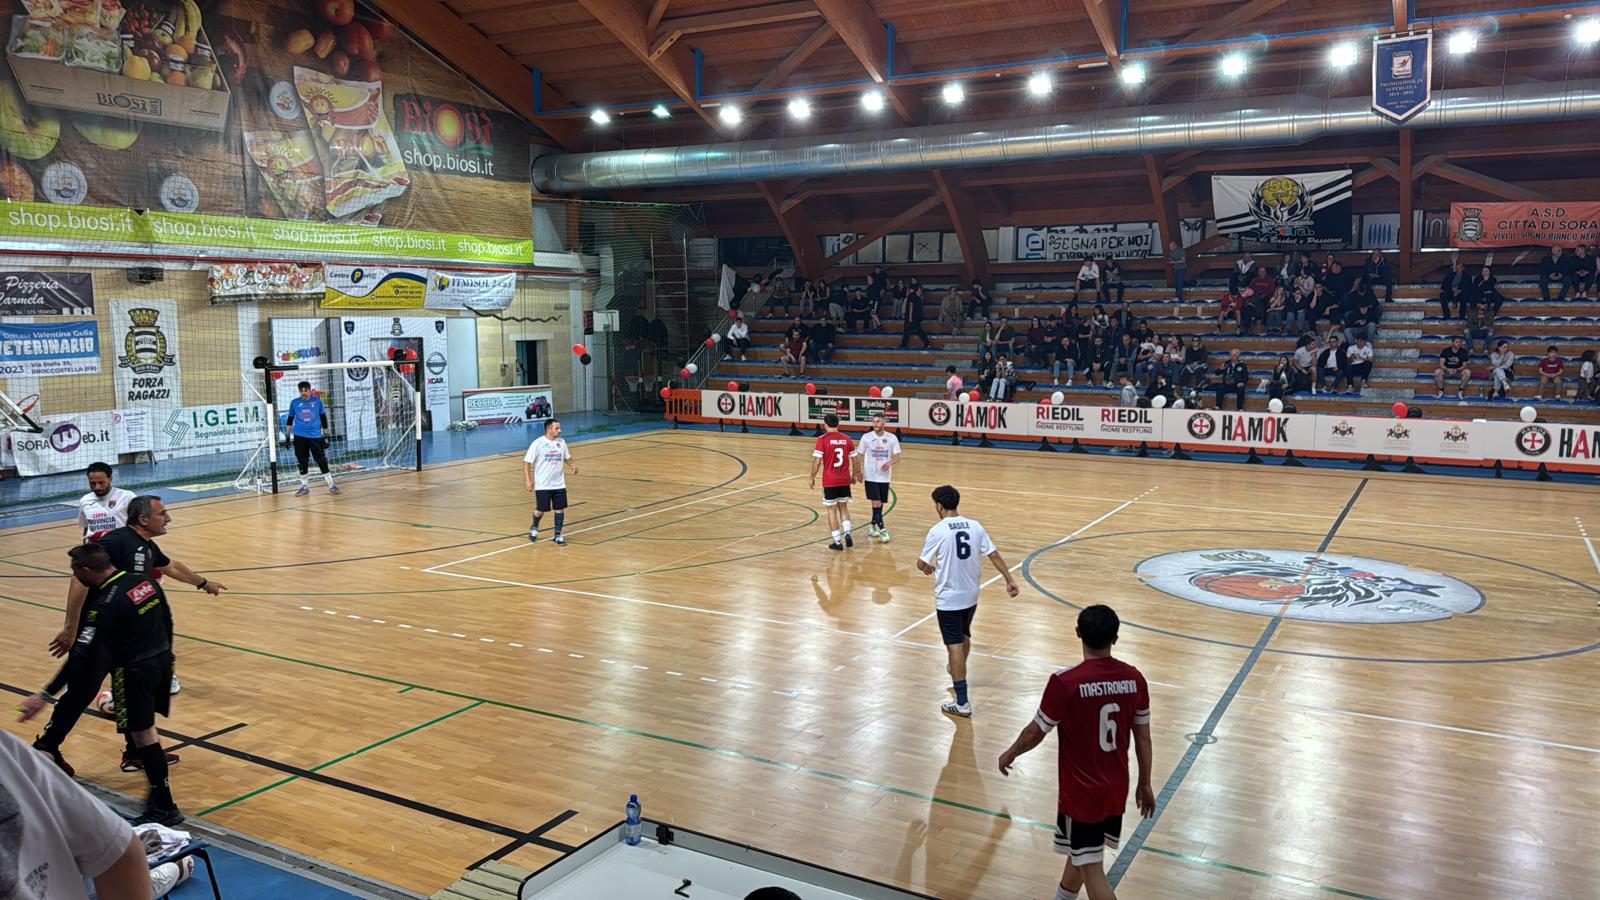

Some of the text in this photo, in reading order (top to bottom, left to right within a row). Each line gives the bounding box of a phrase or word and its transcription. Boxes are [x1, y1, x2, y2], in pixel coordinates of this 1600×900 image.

[1541, 220, 1555, 230] DI
[1559, 220, 1598, 230] SORA
[1053, 233, 1151, 251] SEGNA PER NOI
[5, 275, 61, 294] Pizzeria
[32, 330, 72, 340] Valentina
[132, 377, 164, 389] FORZA
[128, 389, 170, 402] RAGAZZI
[467, 396, 503, 409] RECCHIA
[739, 394, 782, 418] HAMOK
[1036, 406, 1084, 421] RIEDIL
[956, 403, 1008, 429] HAMOK
[1101, 408, 1153, 424] RIEDIL
[194, 429, 236, 439] Segnaletica
[1037, 423, 1085, 432] HOME RESTYLING
[1102, 425, 1153, 434] HOME RESTYLING
[1221, 414, 1290, 444] HAMOK
[833, 447, 844, 468] 3
[948, 521, 970, 530] BASILE
[955, 531, 971, 560] 6
[1098, 702, 1121, 753] 6
